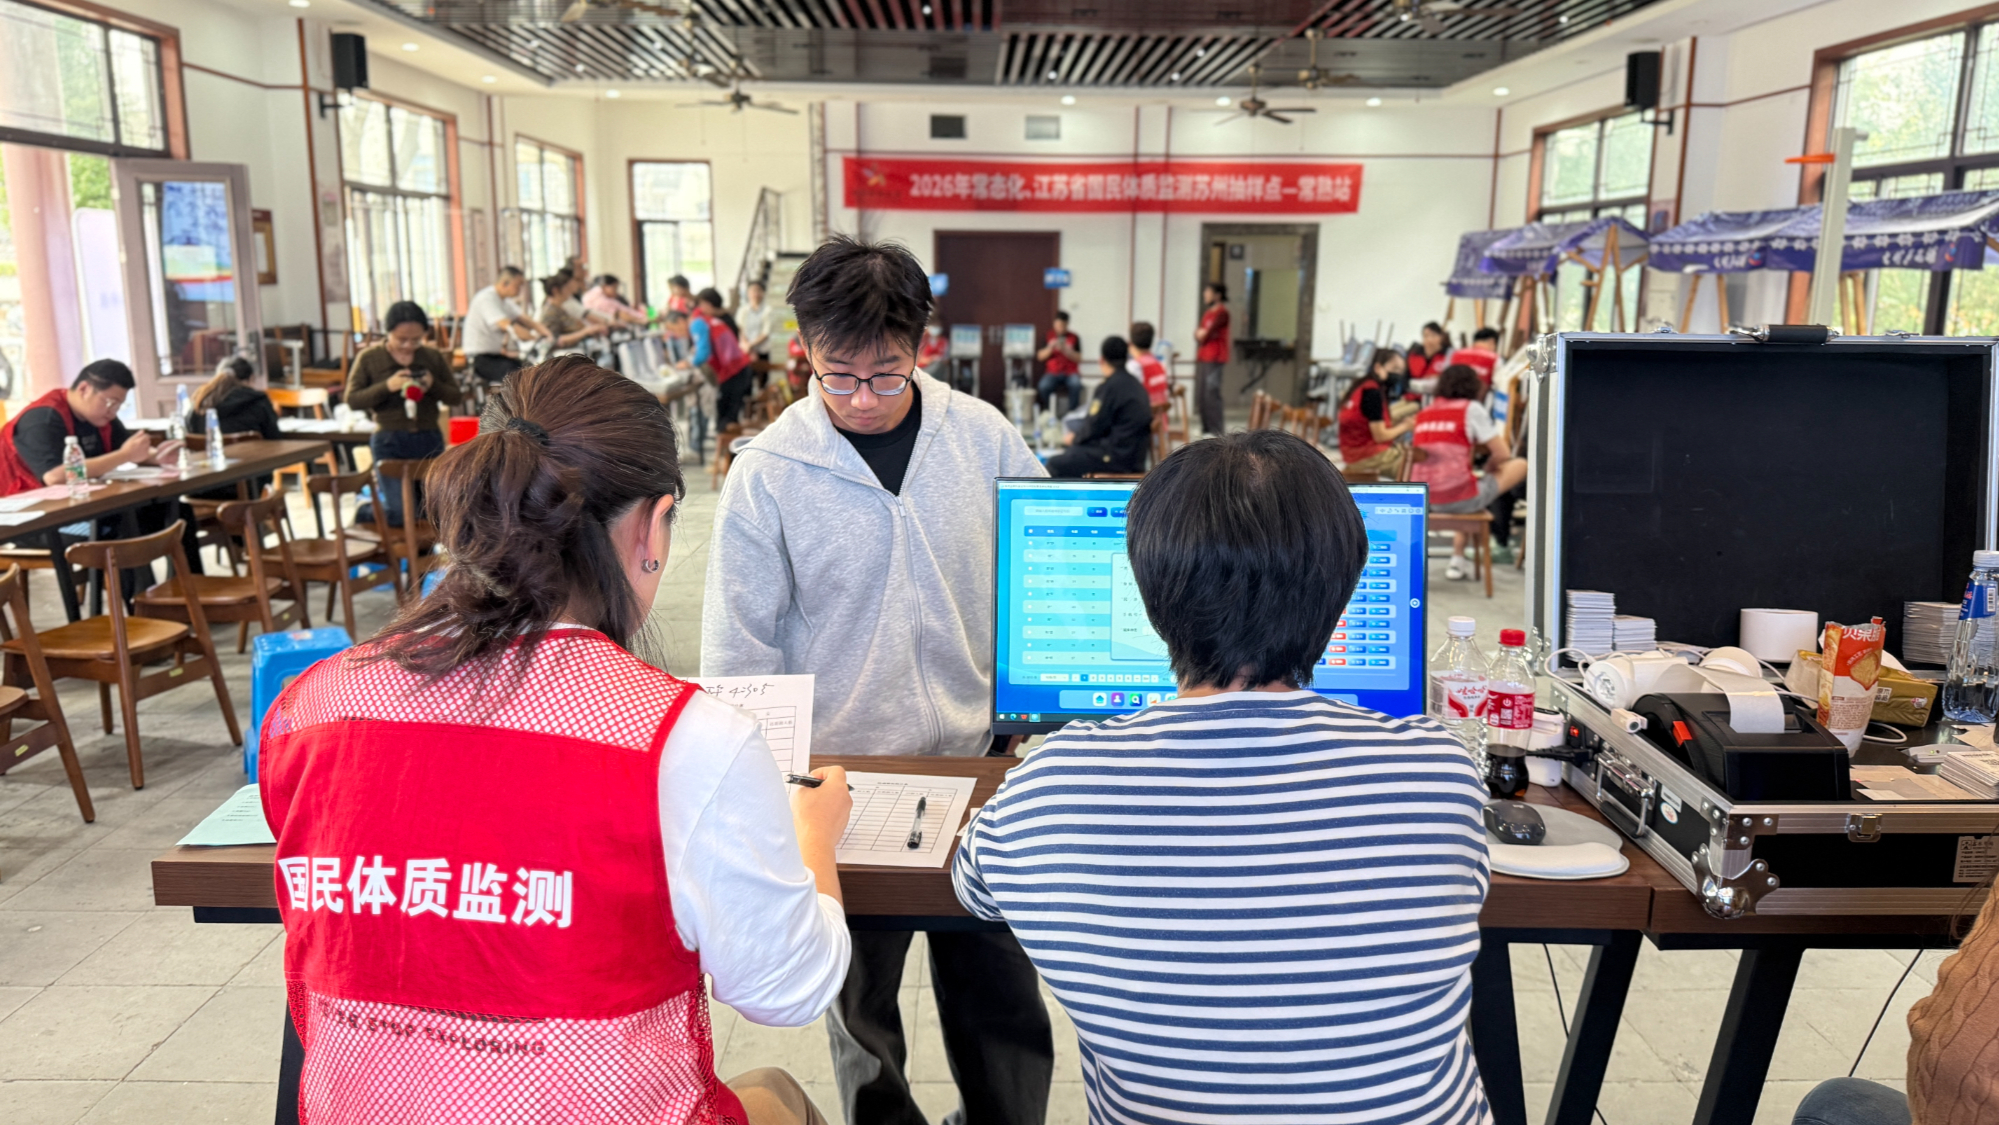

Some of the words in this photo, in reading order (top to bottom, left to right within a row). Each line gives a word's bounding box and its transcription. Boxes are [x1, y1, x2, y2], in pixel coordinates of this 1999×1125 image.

[278, 855, 573, 928] 国民体质监测
